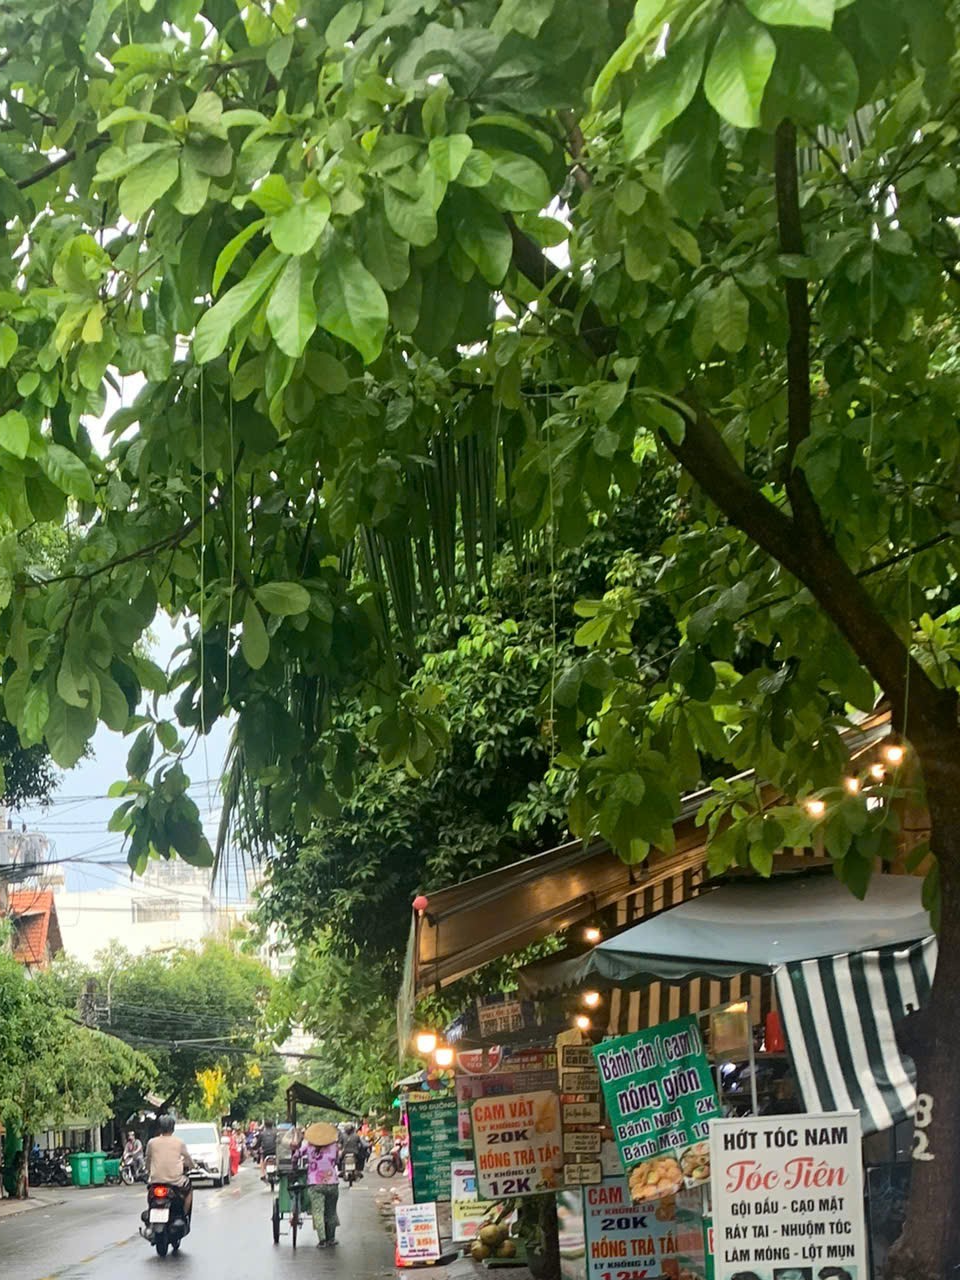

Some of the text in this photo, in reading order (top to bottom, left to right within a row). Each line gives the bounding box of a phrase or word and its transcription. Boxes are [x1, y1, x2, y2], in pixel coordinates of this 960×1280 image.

[598, 1046, 635, 1083] Bánh
[618, 1082, 661, 1116] nóng
[474, 1104, 505, 1122] CAM
[618, 1097, 716, 1141] Bánh Ngọt 2K
[487, 1129, 529, 1145] 20K
[723, 1126, 848, 1151] HỚT TÓC NAM
[623, 1139, 656, 1162] Bánh
[725, 1156, 849, 1193] Tóc Tiên
[489, 1177, 532, 1196] 12K
[587, 1186, 623, 1206] CAM
[791, 1199, 815, 1216] CẠO
[601, 1215, 648, 1231] 20K
[751, 1224, 769, 1238] TAI
[781, 1220, 825, 1240] NHUỘM
[829, 1219, 852, 1235] TÓC
[630, 1234, 656, 1256] TRÀ
[754, 1245, 790, 1262] MÓNG
[826, 1244, 855, 1261] MỤN
